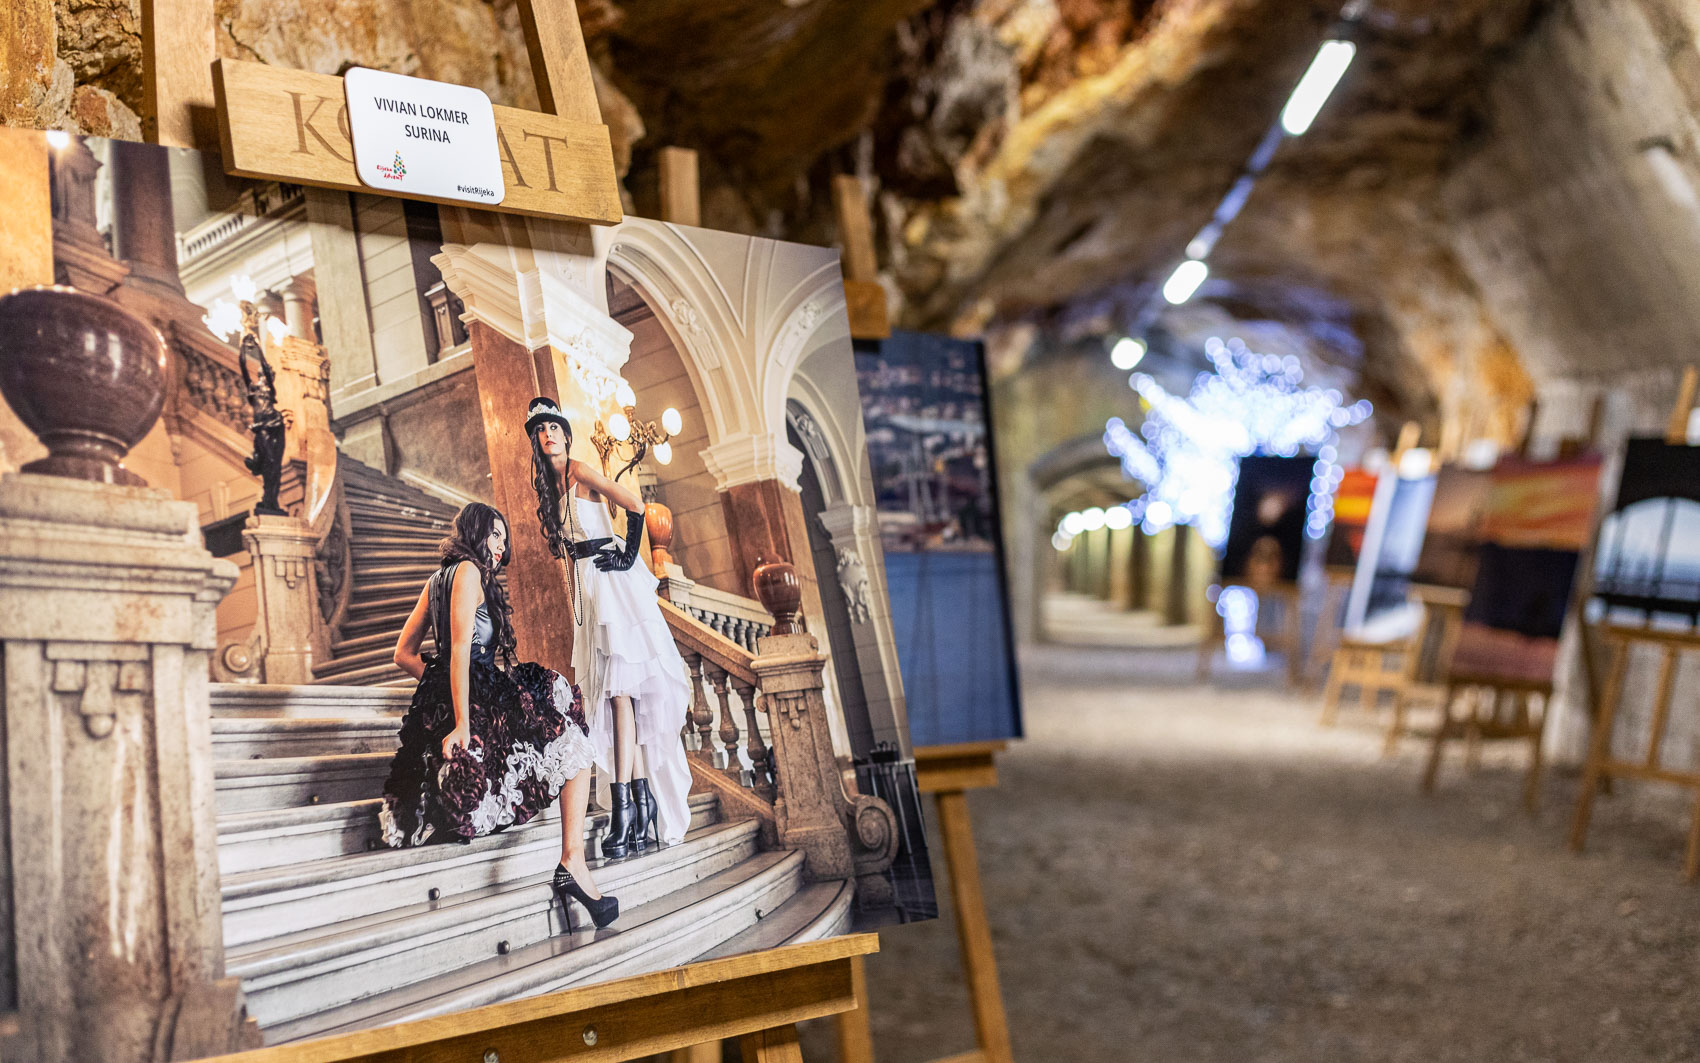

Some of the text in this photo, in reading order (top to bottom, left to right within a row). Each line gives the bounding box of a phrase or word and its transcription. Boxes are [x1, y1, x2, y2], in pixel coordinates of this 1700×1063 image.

[374, 96, 469, 125] VIVIAN LOKMER
[404, 124, 451, 143] SURINA
[457, 184, 495, 197] #visitRijeka
